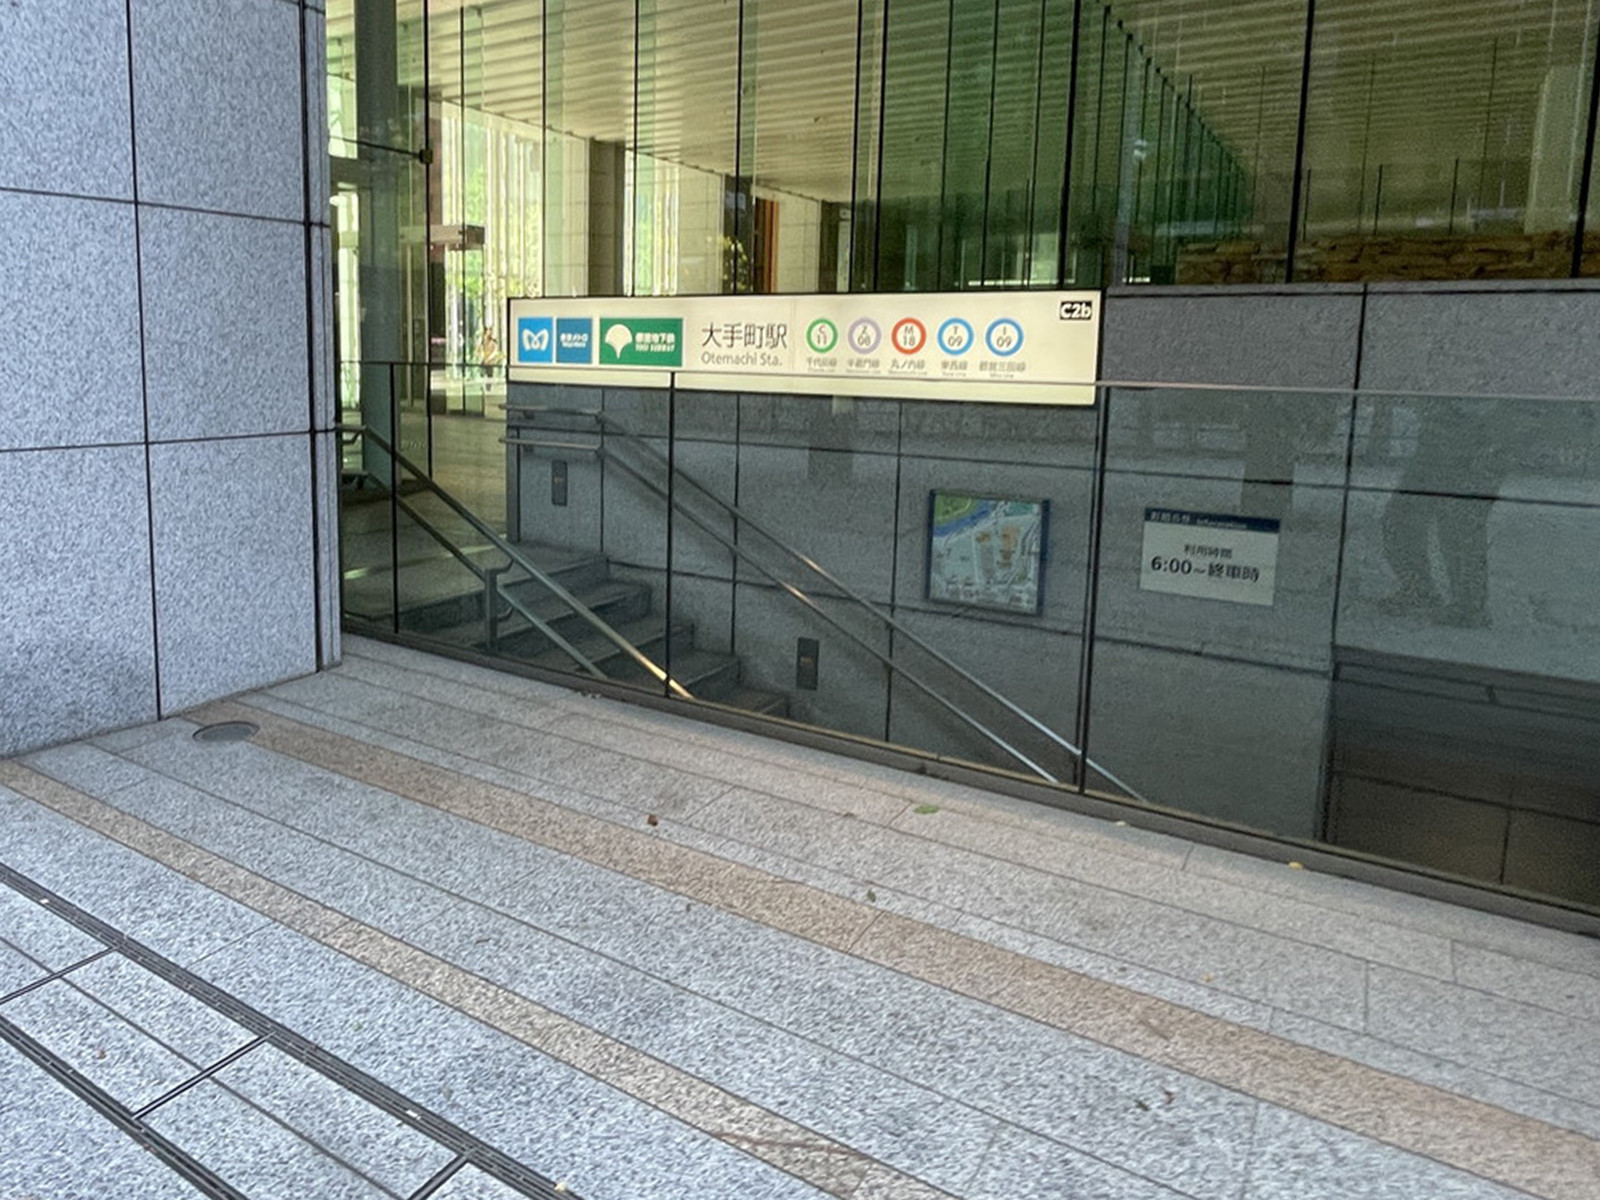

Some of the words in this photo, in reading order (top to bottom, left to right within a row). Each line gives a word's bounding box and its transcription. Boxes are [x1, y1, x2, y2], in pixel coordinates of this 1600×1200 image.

[1060, 302, 1092, 319] C2b
[701, 322, 788, 349] 大手町駅
[903, 326, 914, 334] M
[902, 335, 916, 347] 18
[947, 336, 963, 348] 09
[996, 336, 1012, 348] 09
[701, 351, 757, 366] Otemachi
[760, 352, 783, 367] Sta.
